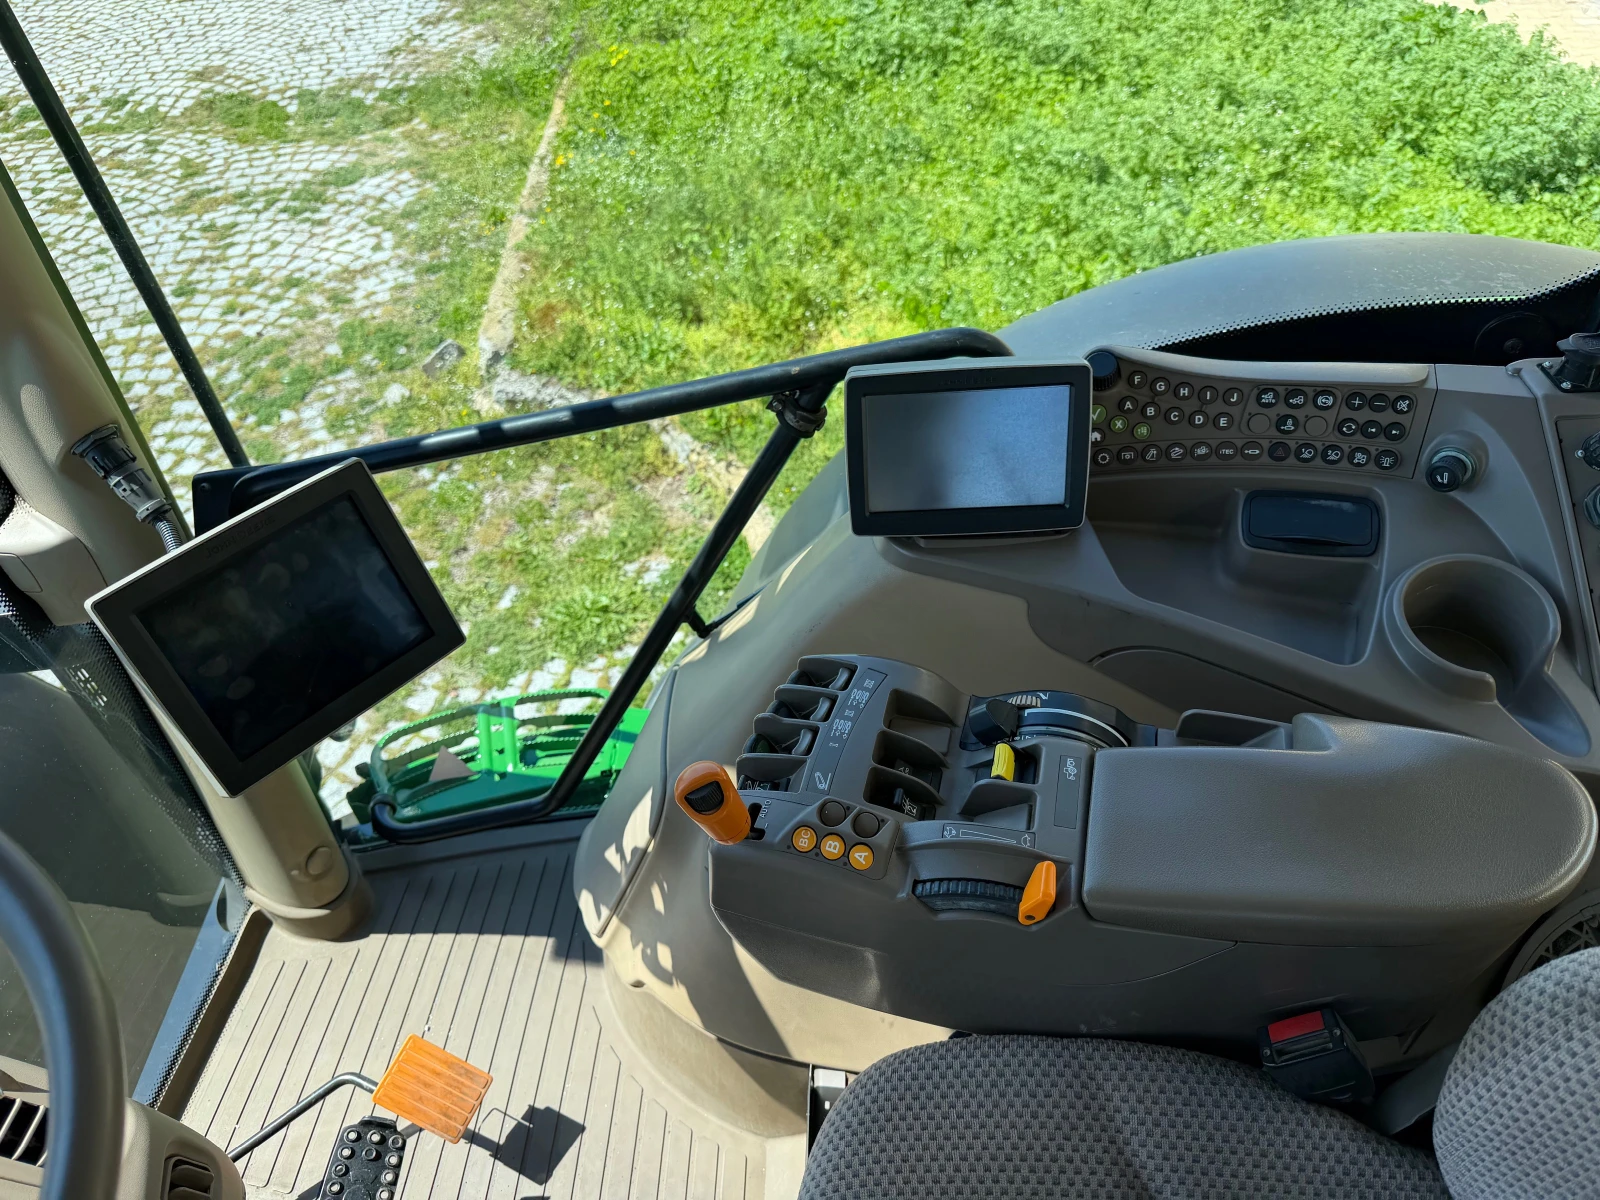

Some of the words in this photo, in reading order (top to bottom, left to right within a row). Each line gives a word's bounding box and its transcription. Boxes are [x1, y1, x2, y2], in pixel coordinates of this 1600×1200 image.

[759, 799, 772, 818] AUTO
[798, 829, 811, 847] BC
[825, 840, 840, 853] B
[854, 851, 869, 865] A
